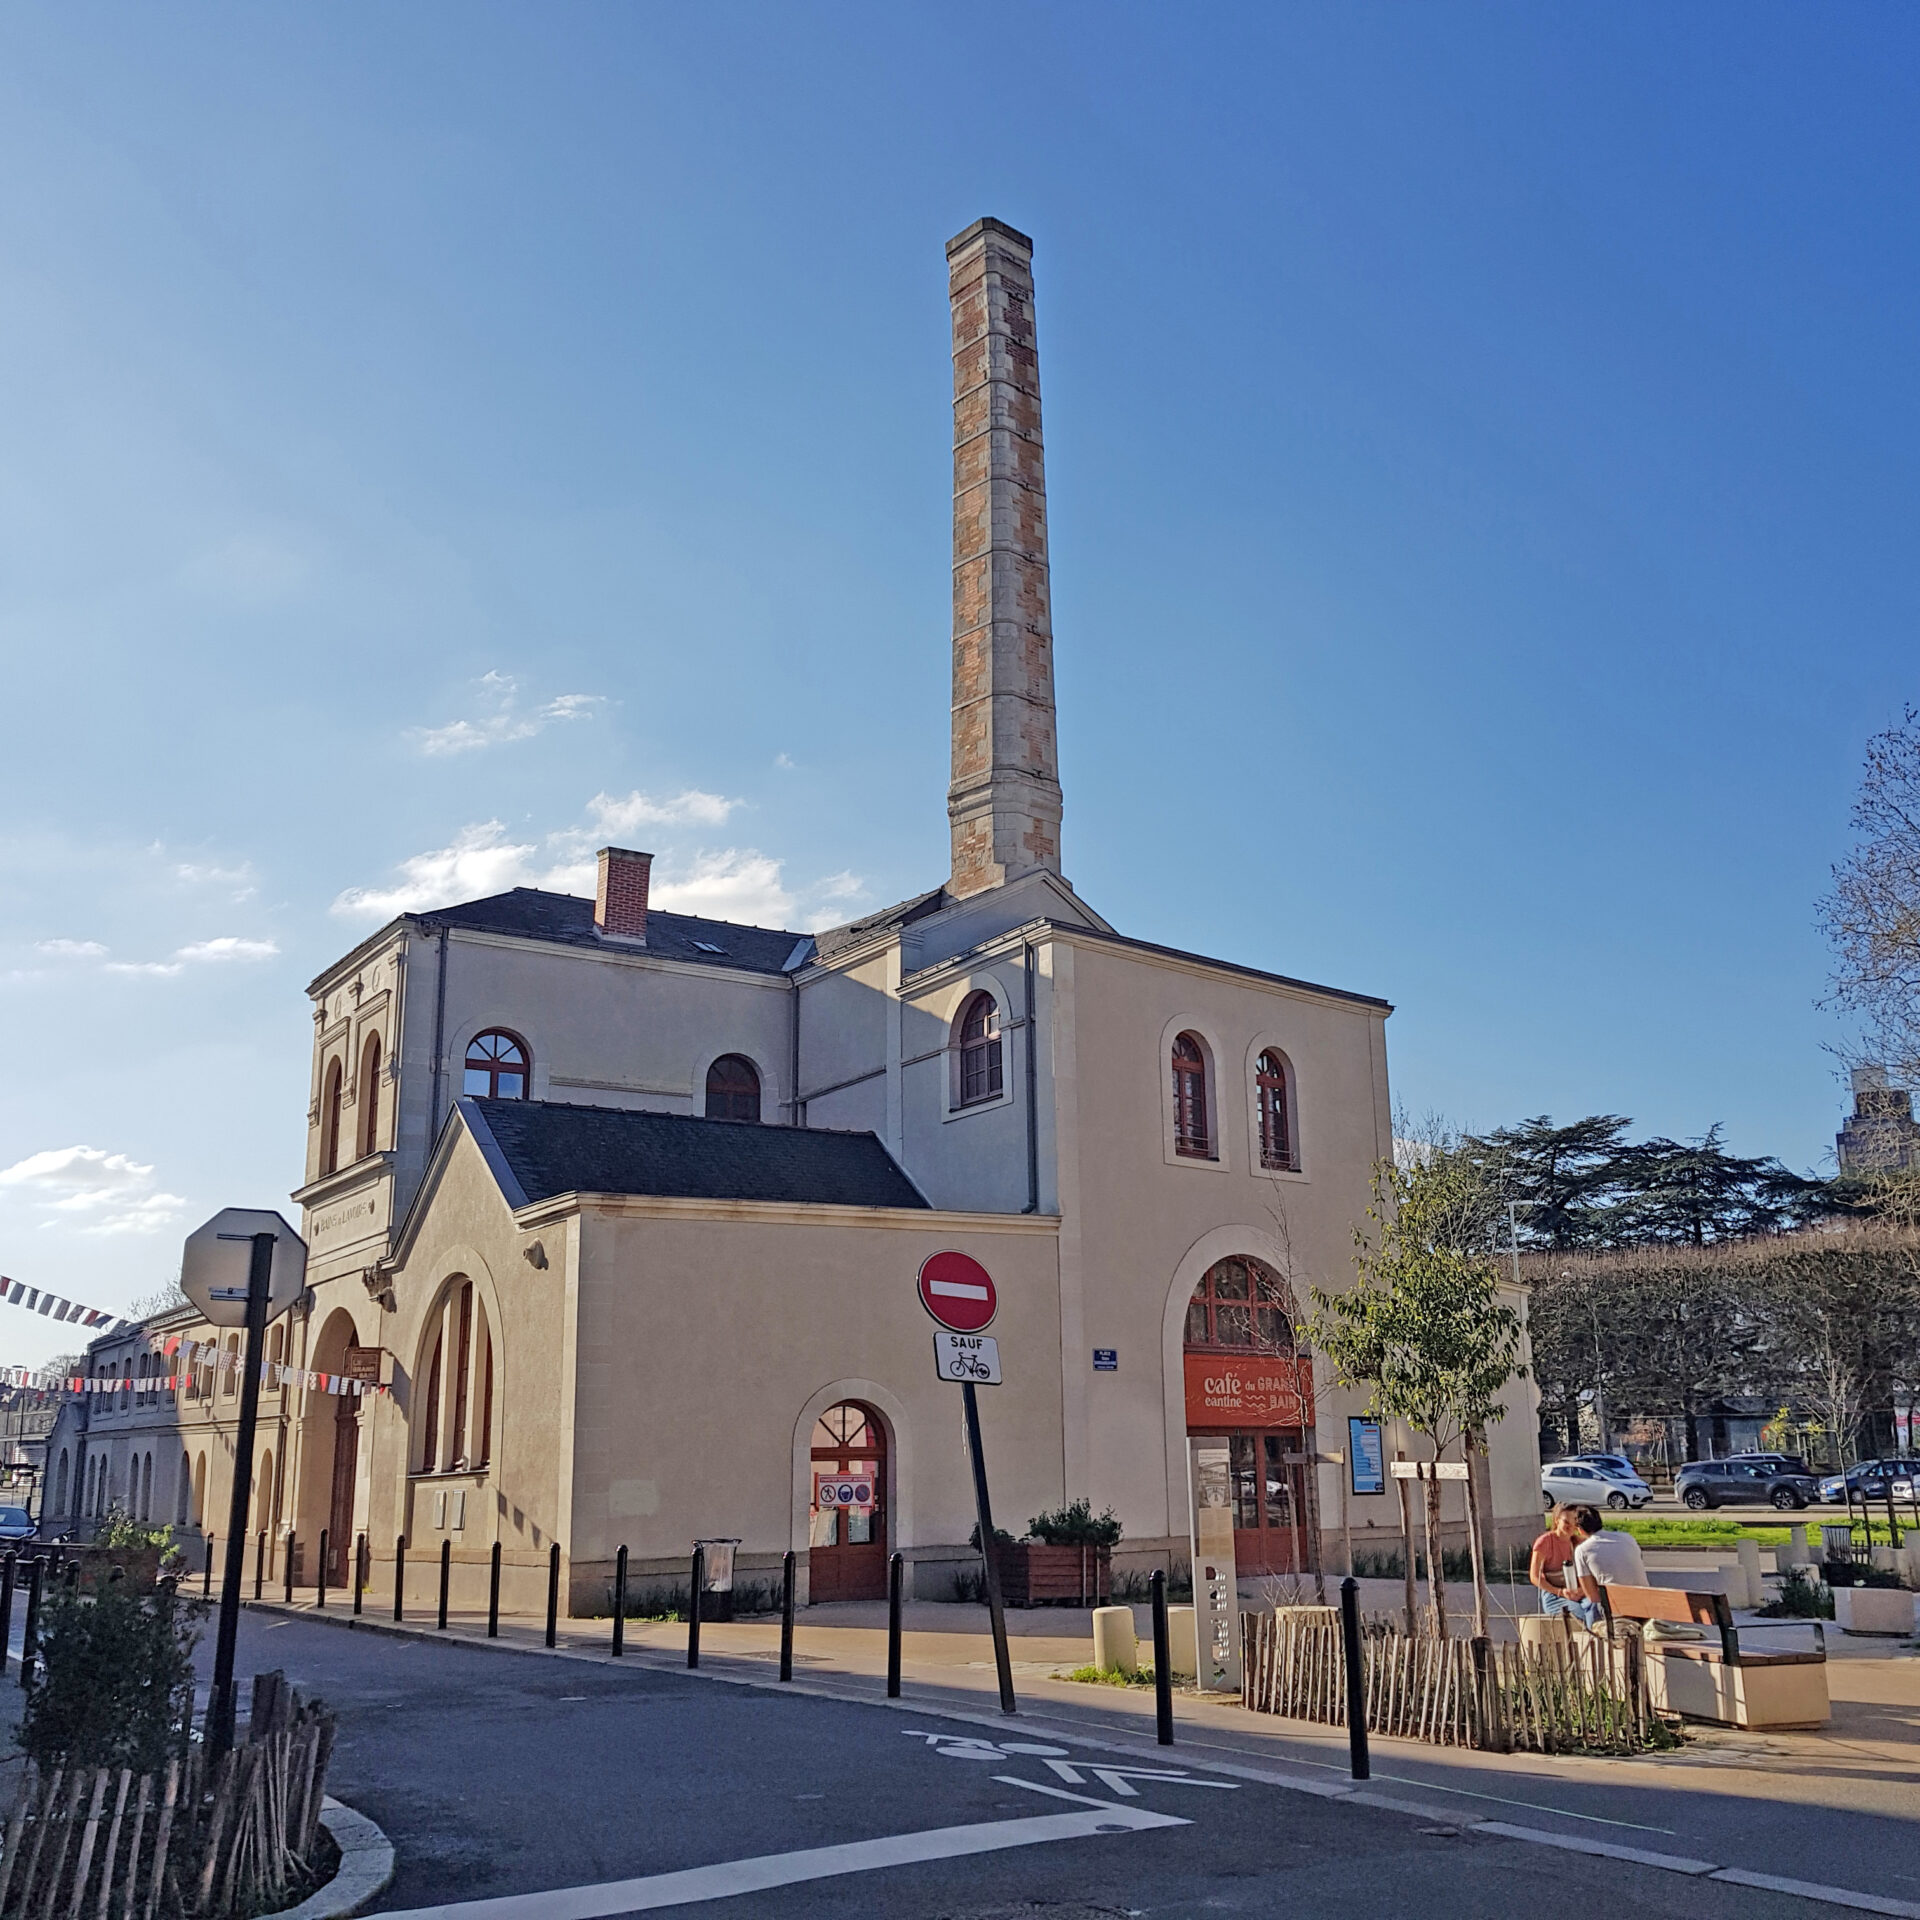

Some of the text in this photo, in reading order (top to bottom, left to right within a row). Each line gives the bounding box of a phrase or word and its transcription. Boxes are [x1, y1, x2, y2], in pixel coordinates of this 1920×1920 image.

[950, 1336, 982, 1350] SAUF
[1204, 1372, 1242, 1395] café
[1245, 1380, 1255, 1391] du
[1204, 1394, 1297, 1409] cantine BAIN
